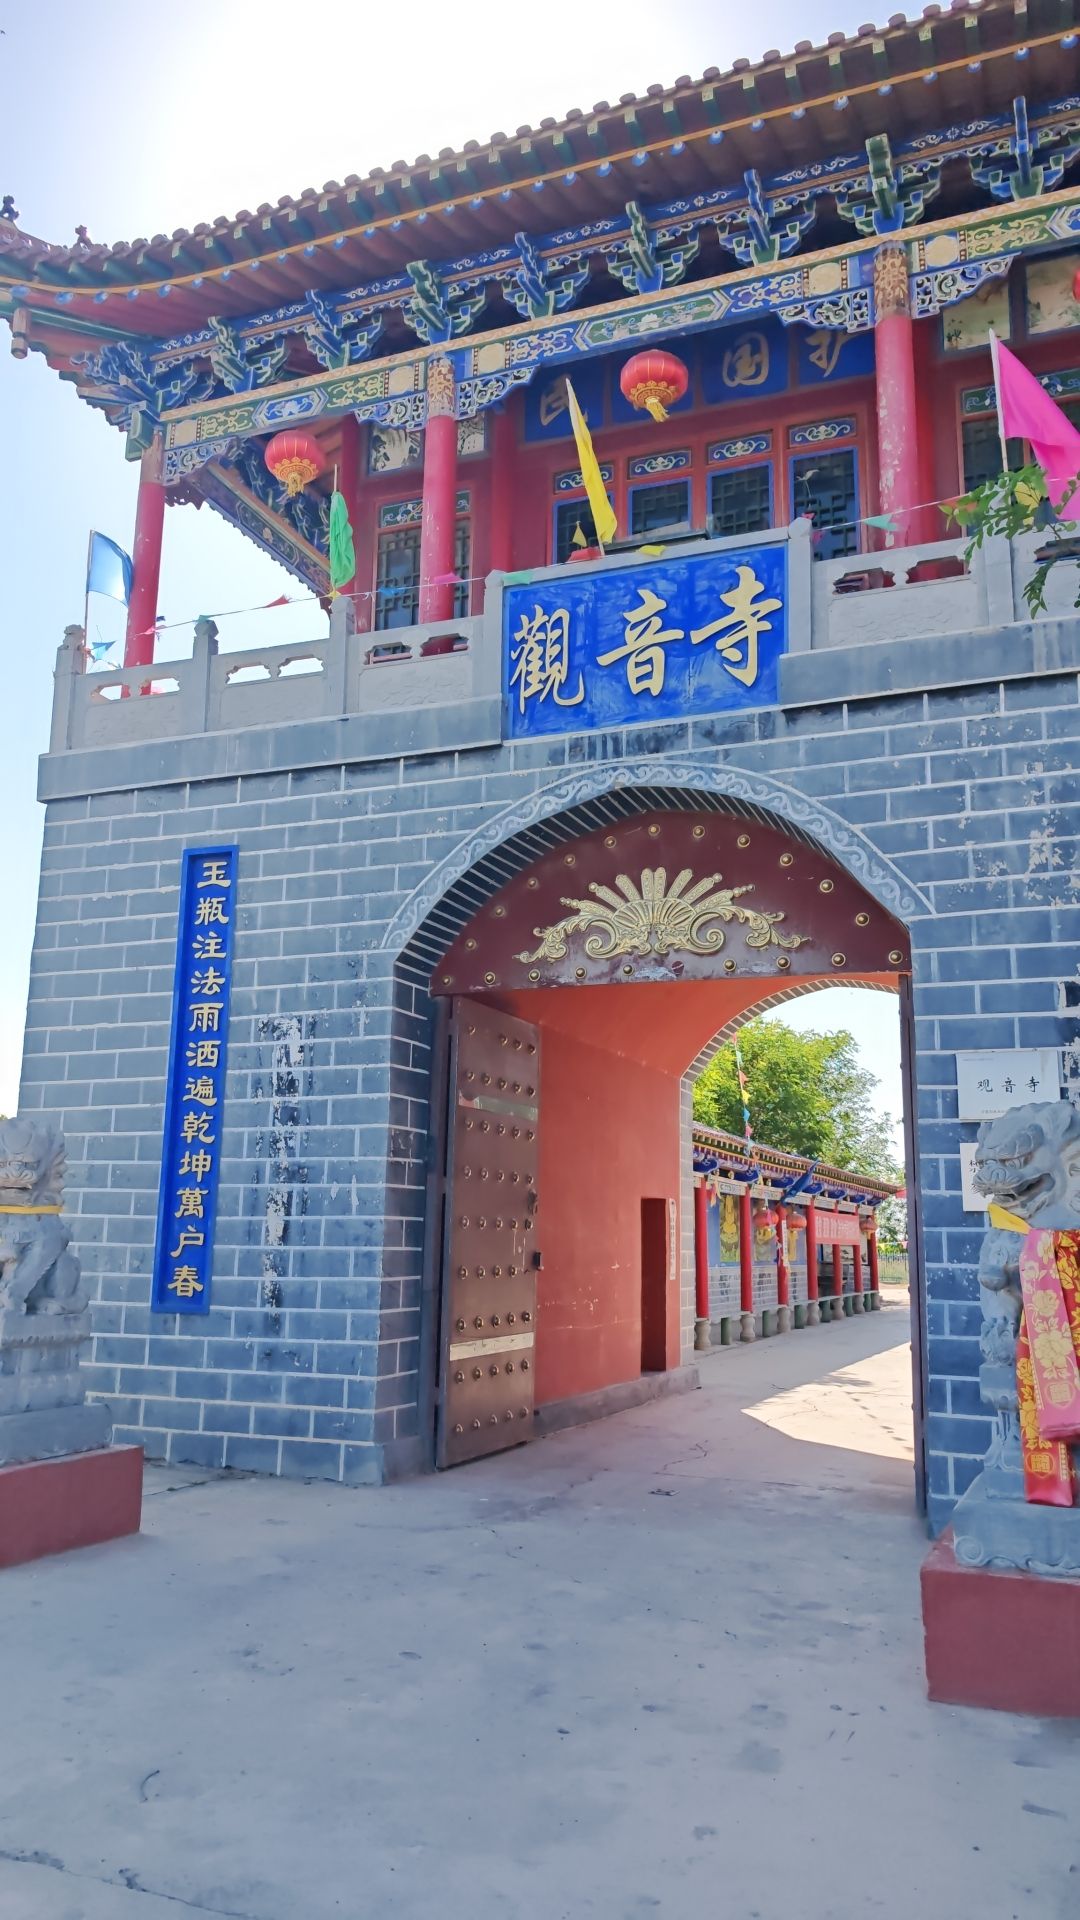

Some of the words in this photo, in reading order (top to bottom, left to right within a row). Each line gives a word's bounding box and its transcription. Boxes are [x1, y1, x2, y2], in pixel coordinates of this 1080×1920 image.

[508, 565, 783, 714] 觀音寺
[976, 1075, 1040, 1094] 观音寺
